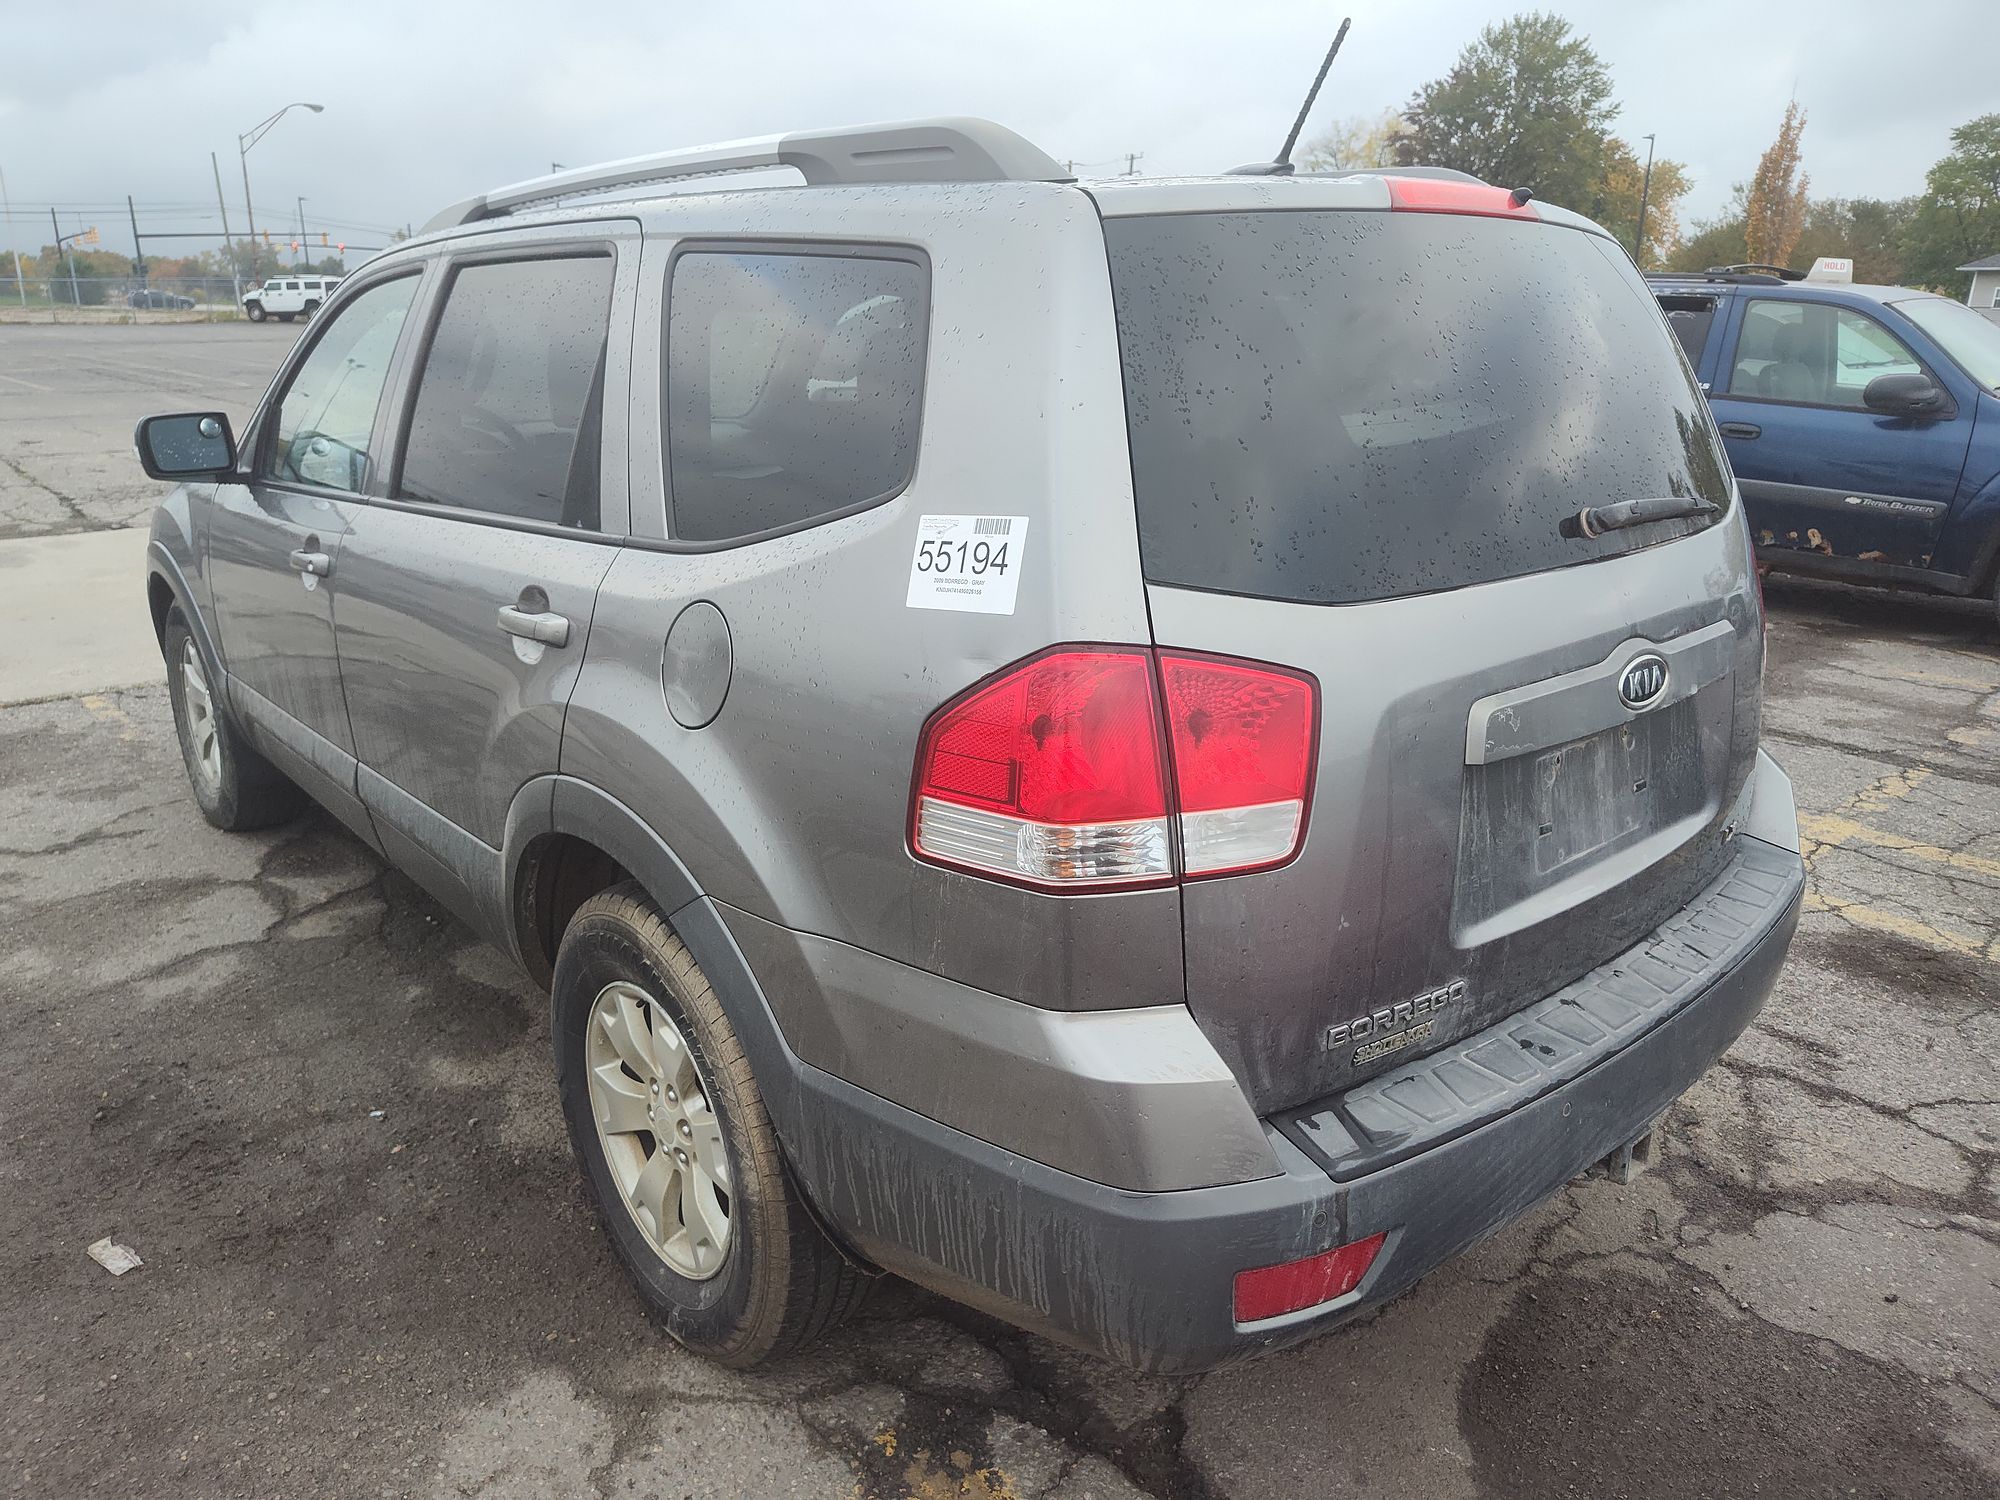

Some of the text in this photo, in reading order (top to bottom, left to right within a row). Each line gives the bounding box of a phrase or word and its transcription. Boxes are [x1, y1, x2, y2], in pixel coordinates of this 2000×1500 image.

[1823, 261, 1846, 271] HOLD
[917, 540, 1009, 576] 55194
[1628, 665, 1662, 700] KIA
[1327, 979, 1466, 1050] BORREGO
